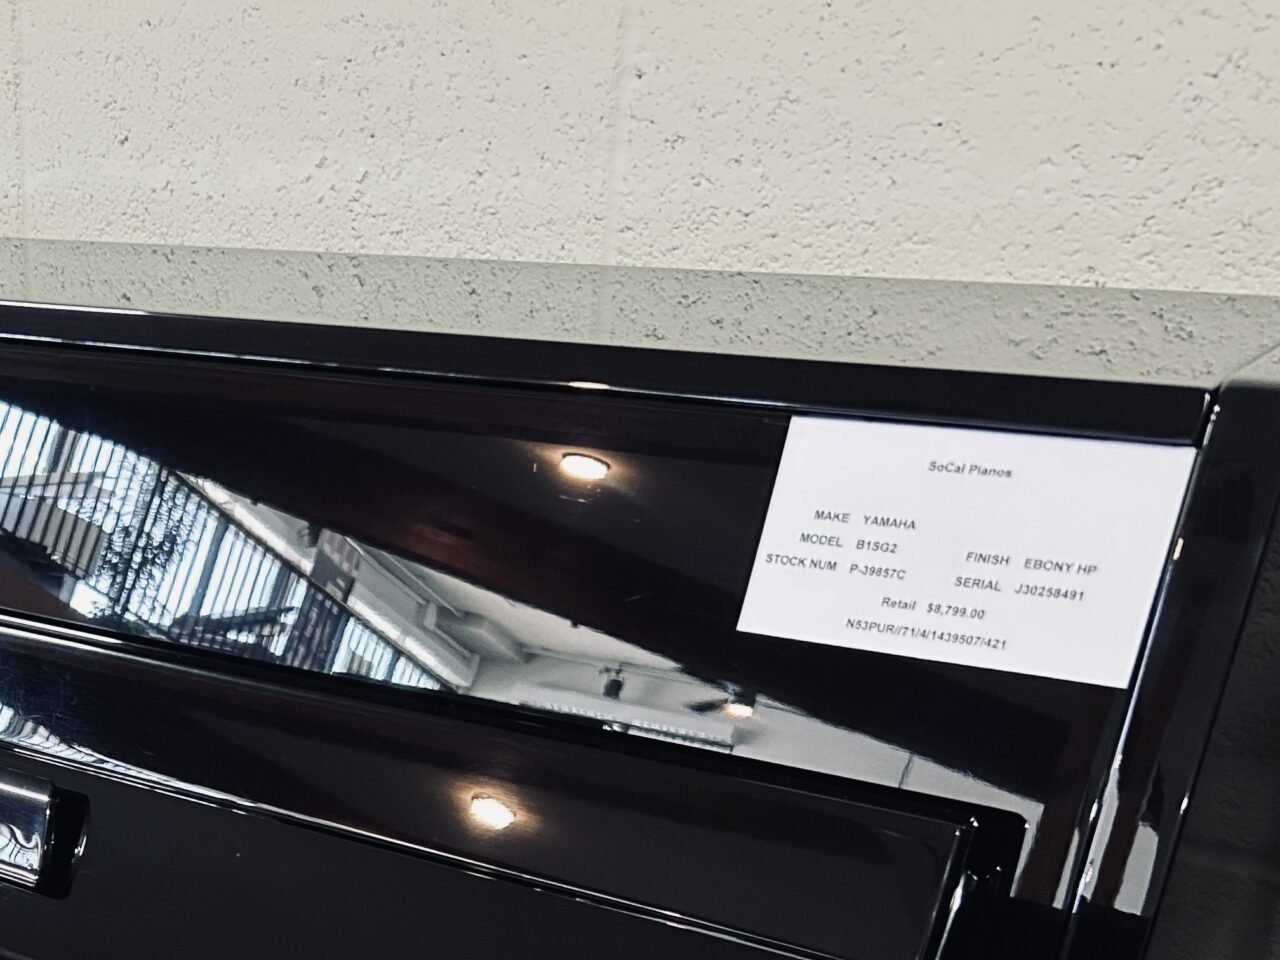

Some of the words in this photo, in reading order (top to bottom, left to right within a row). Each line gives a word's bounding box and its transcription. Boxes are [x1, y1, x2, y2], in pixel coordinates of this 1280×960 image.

[928, 461, 965, 475] SoCal
[968, 465, 1013, 478] Pianos
[814, 510, 850, 523] MAKE
[863, 515, 916, 530] YAMAHA
[800, 533, 843, 548] MODEL
[856, 539, 898, 554] B1SG2
[765, 553, 807, 569] STOCK
[809, 559, 837, 572] NUM
[849, 564, 906, 580] P-39857C
[965, 552, 1010, 566] FINISH
[1024, 558, 1074, 574] EBONY
[1076, 564, 1098, 576] HP
[954, 577, 1002, 592] SERIAL
[881, 597, 916, 611] Retail
[926, 602, 985, 620] $8,799.00
